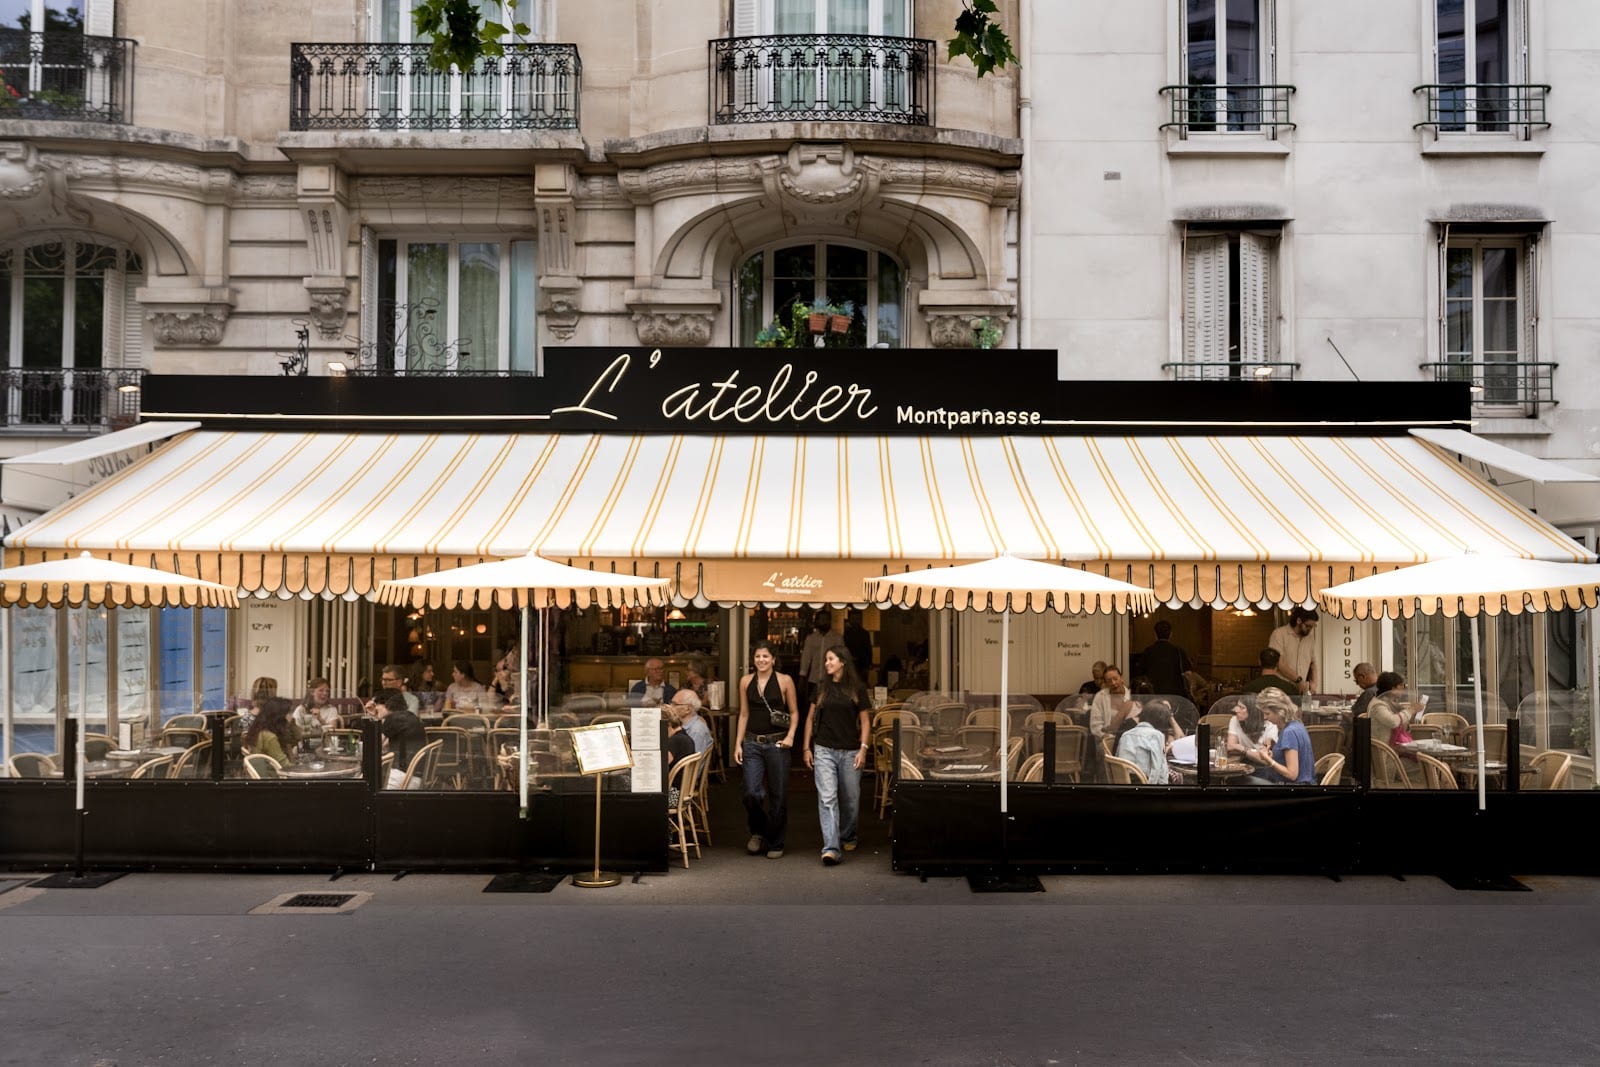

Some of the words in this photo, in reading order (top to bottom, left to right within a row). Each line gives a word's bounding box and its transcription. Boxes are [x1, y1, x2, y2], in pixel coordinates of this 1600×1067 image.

[896, 405, 1041, 430] Montparnasse
[255, 645, 270, 653] 7/7
[1343, 626, 1351, 679] HOURS
